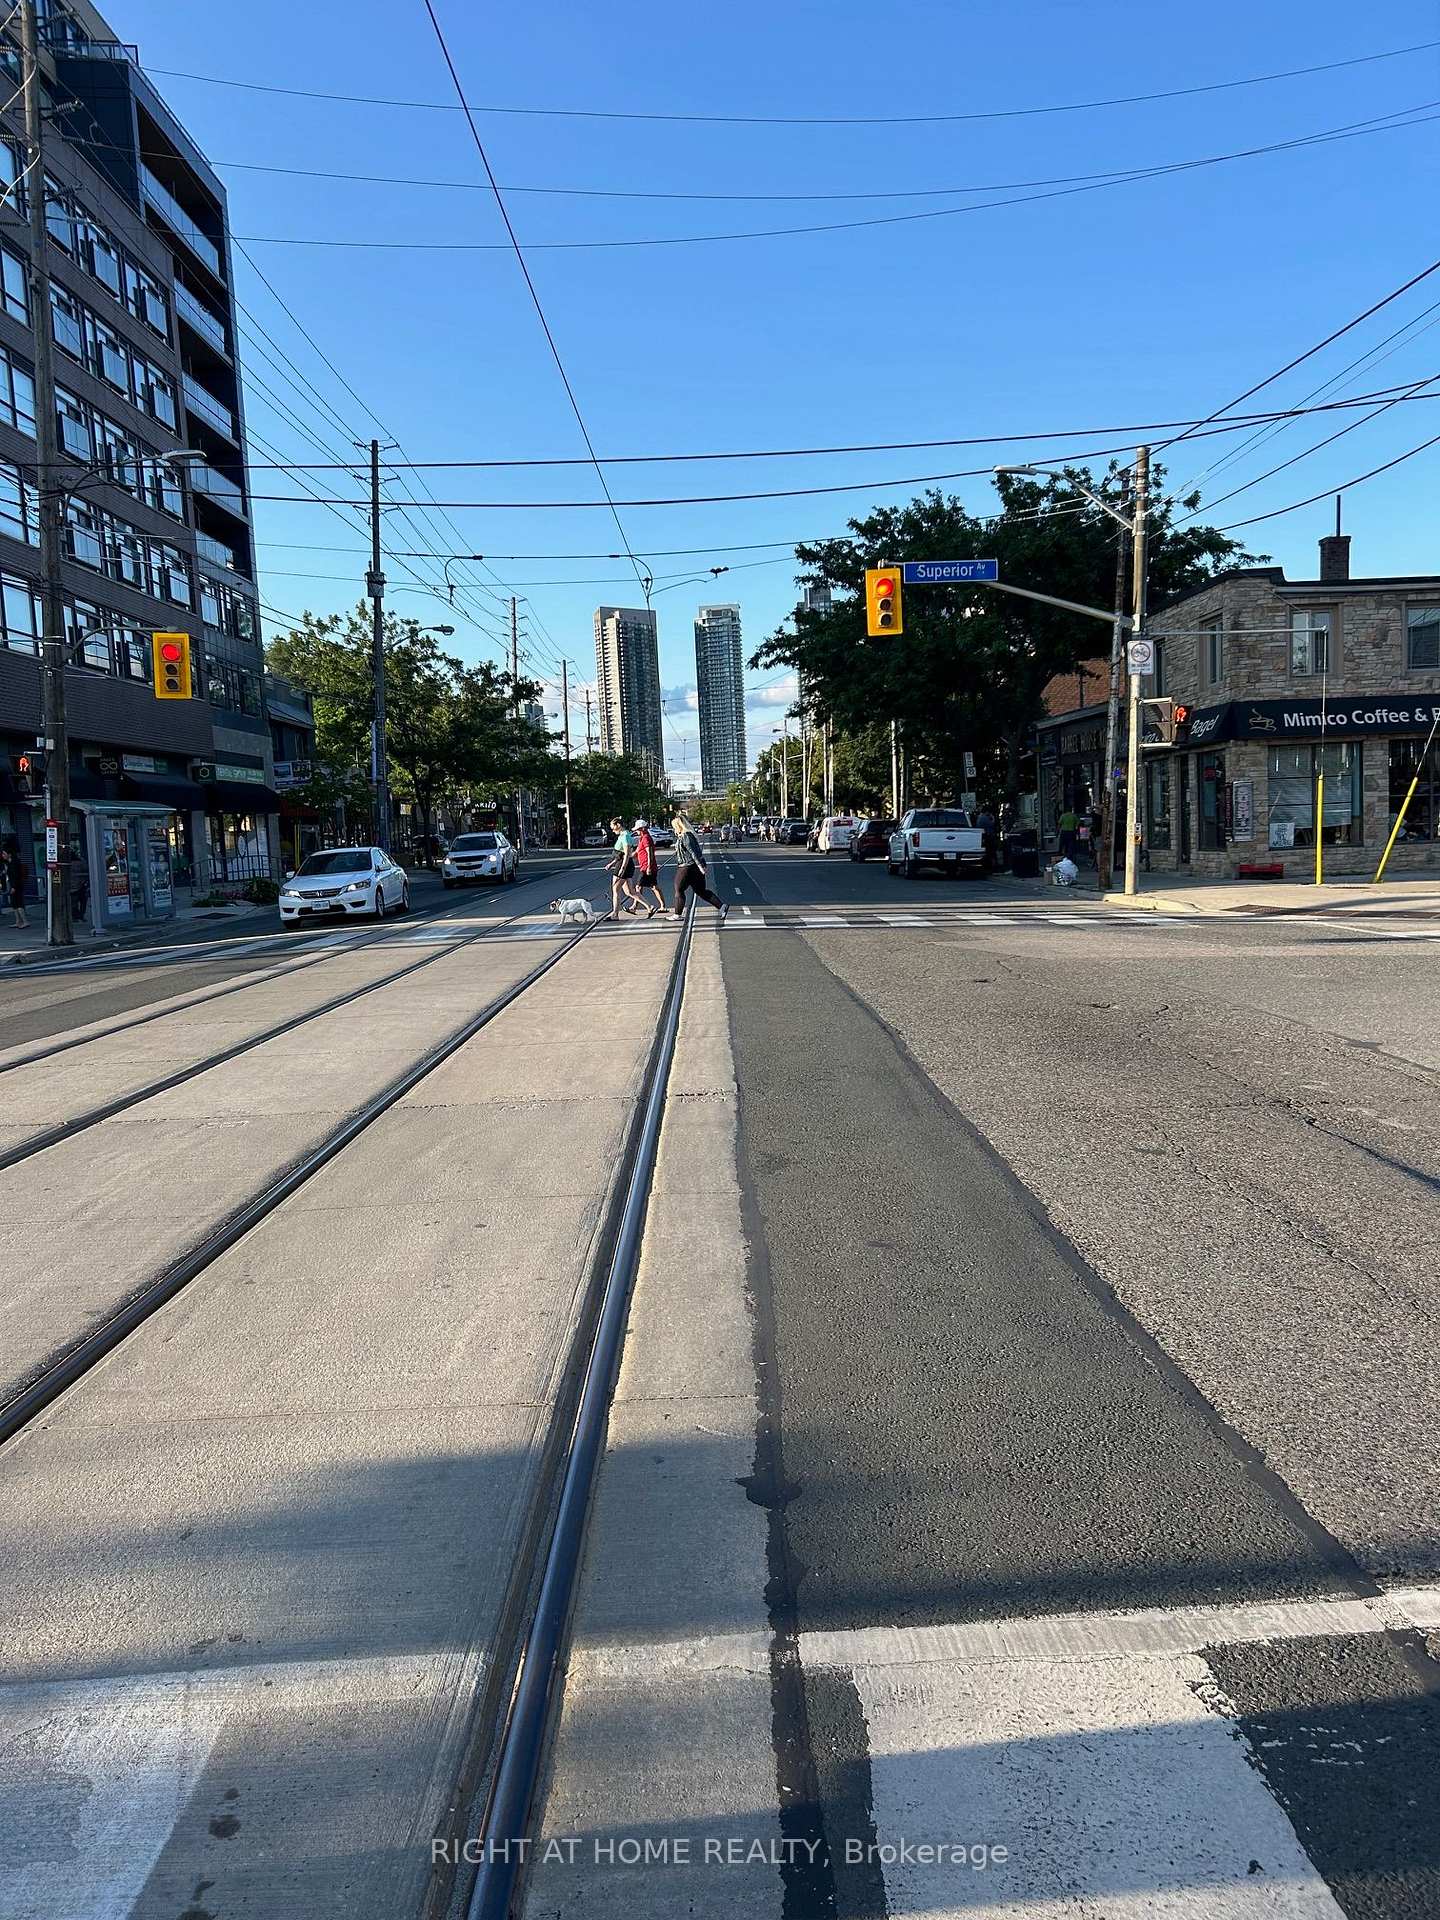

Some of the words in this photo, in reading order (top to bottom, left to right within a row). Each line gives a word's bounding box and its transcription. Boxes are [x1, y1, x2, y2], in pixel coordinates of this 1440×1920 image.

[916, 563, 974, 580] Superior
[1283, 712, 1348, 727] Mimico
[1351, 709, 1410, 724] Coffee
[1414, 708, 1429, 722] &
